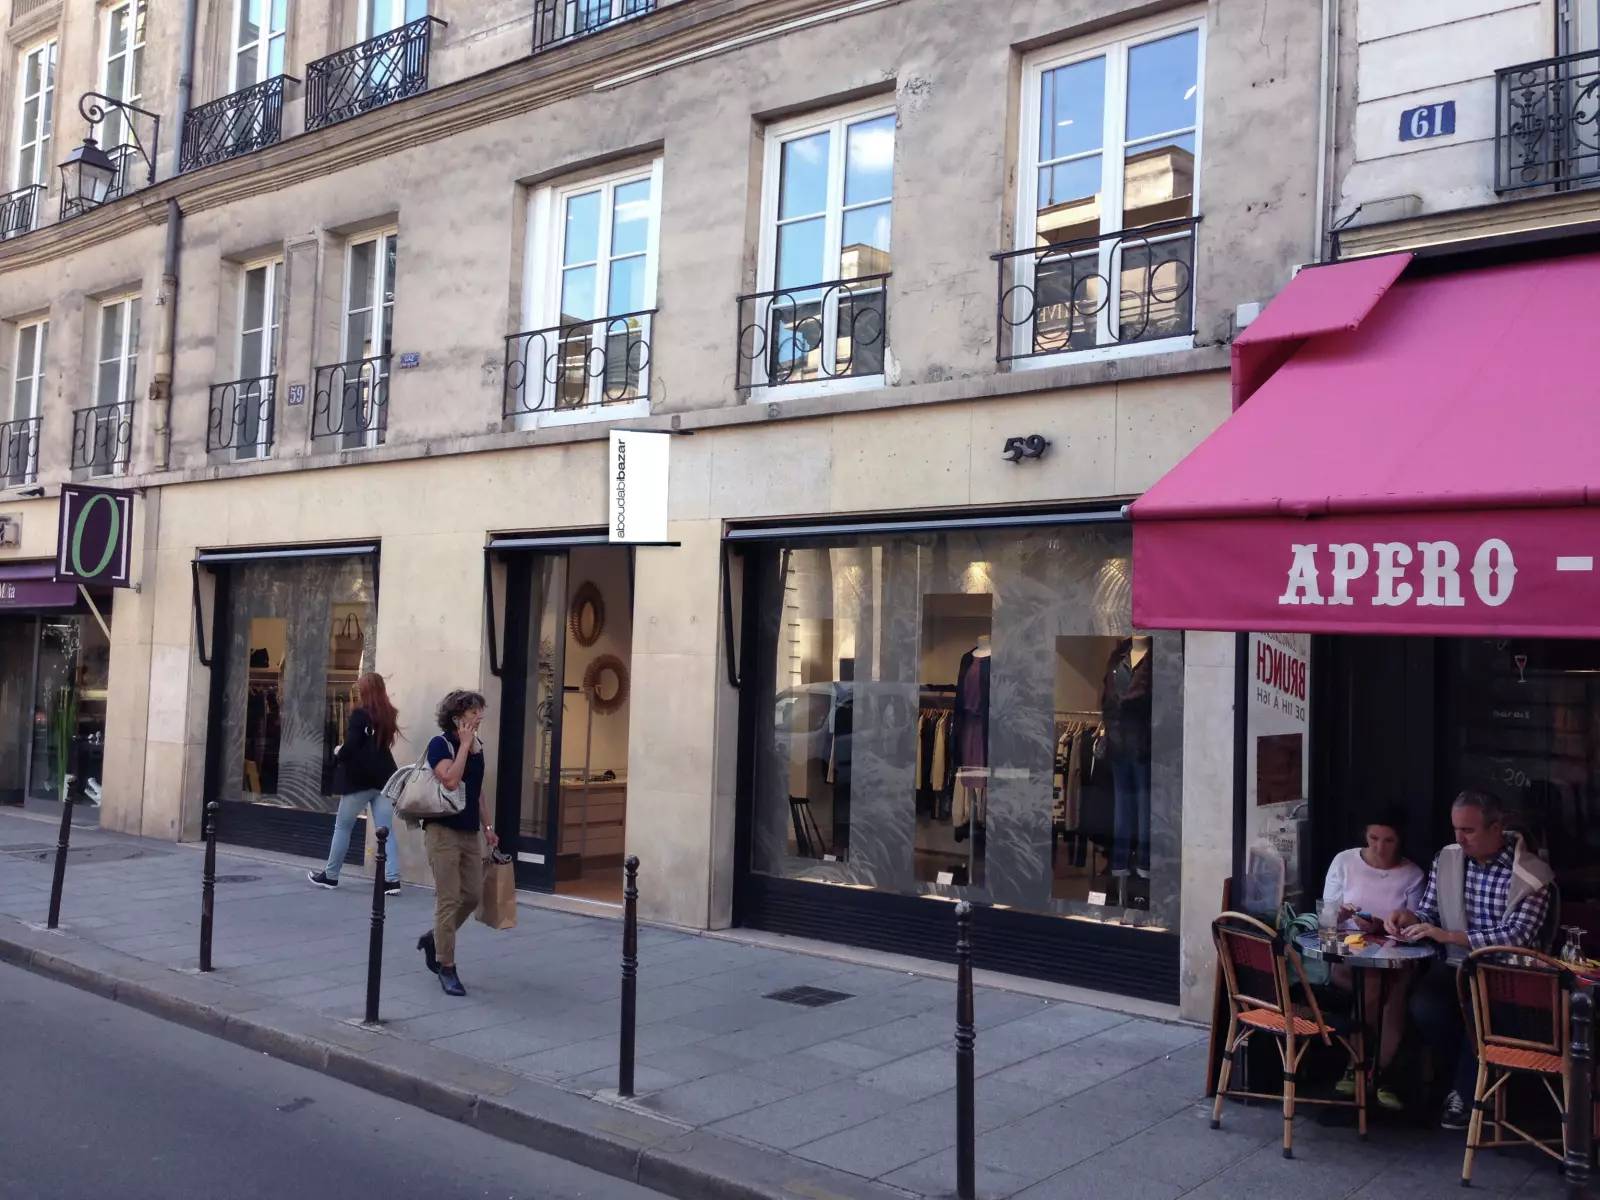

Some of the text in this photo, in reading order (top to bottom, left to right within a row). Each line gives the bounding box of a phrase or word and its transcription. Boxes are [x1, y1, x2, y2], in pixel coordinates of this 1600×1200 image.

[1410, 105, 1444, 138] 61
[290, 386, 303, 403] 59
[1001, 434, 1046, 463] 59
[1278, 538, 1518, 607] APERO
